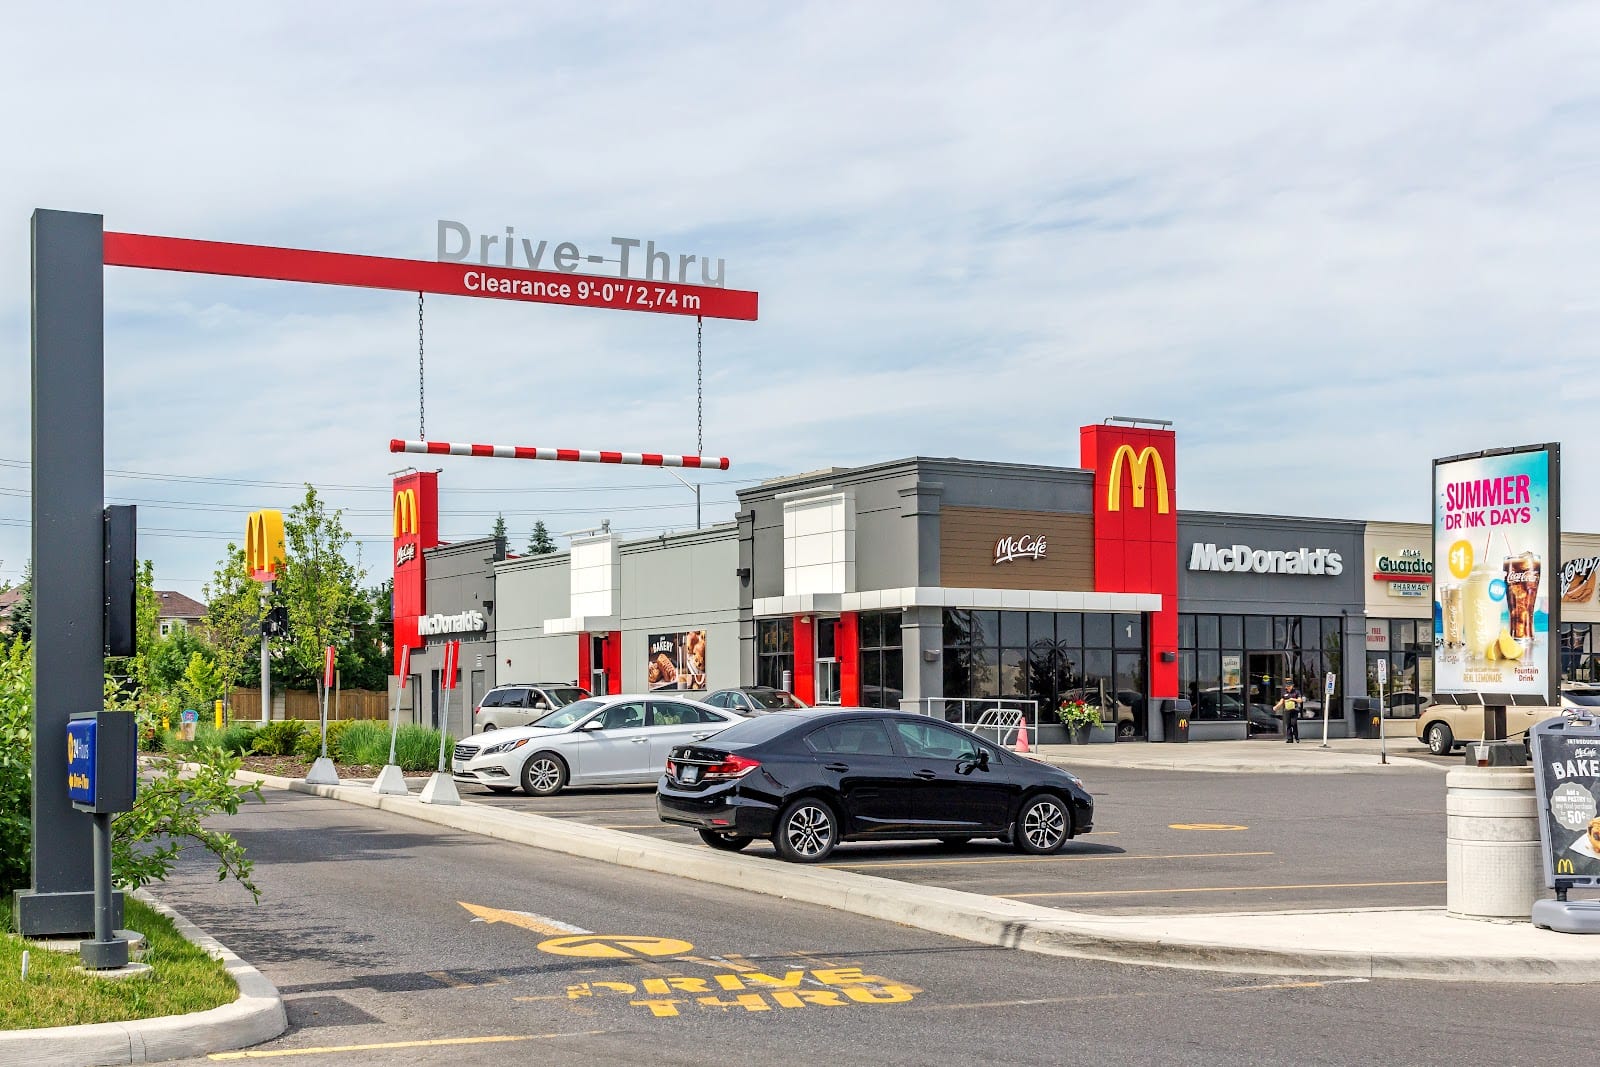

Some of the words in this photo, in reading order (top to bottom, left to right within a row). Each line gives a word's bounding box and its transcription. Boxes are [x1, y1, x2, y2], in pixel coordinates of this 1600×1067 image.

[437, 219, 725, 288] Drive-Thru
[463, 271, 571, 298] Clearance
[682, 293, 701, 309] m
[1446, 474, 1531, 512] SUMMER
[1490, 506, 1531, 526] DAYS
[995, 534, 1048, 564] McCafé
[1189, 542, 1344, 576] McDonald's
[1378, 556, 1432, 573] Guardia
[1392, 583, 1430, 591] PHARMACY
[418, 610, 485, 636] McDonald's
[1125, 624, 1133, 638] 1
[652, 640, 674, 653] BAKERY
[1514, 667, 1539, 675] Fountain
